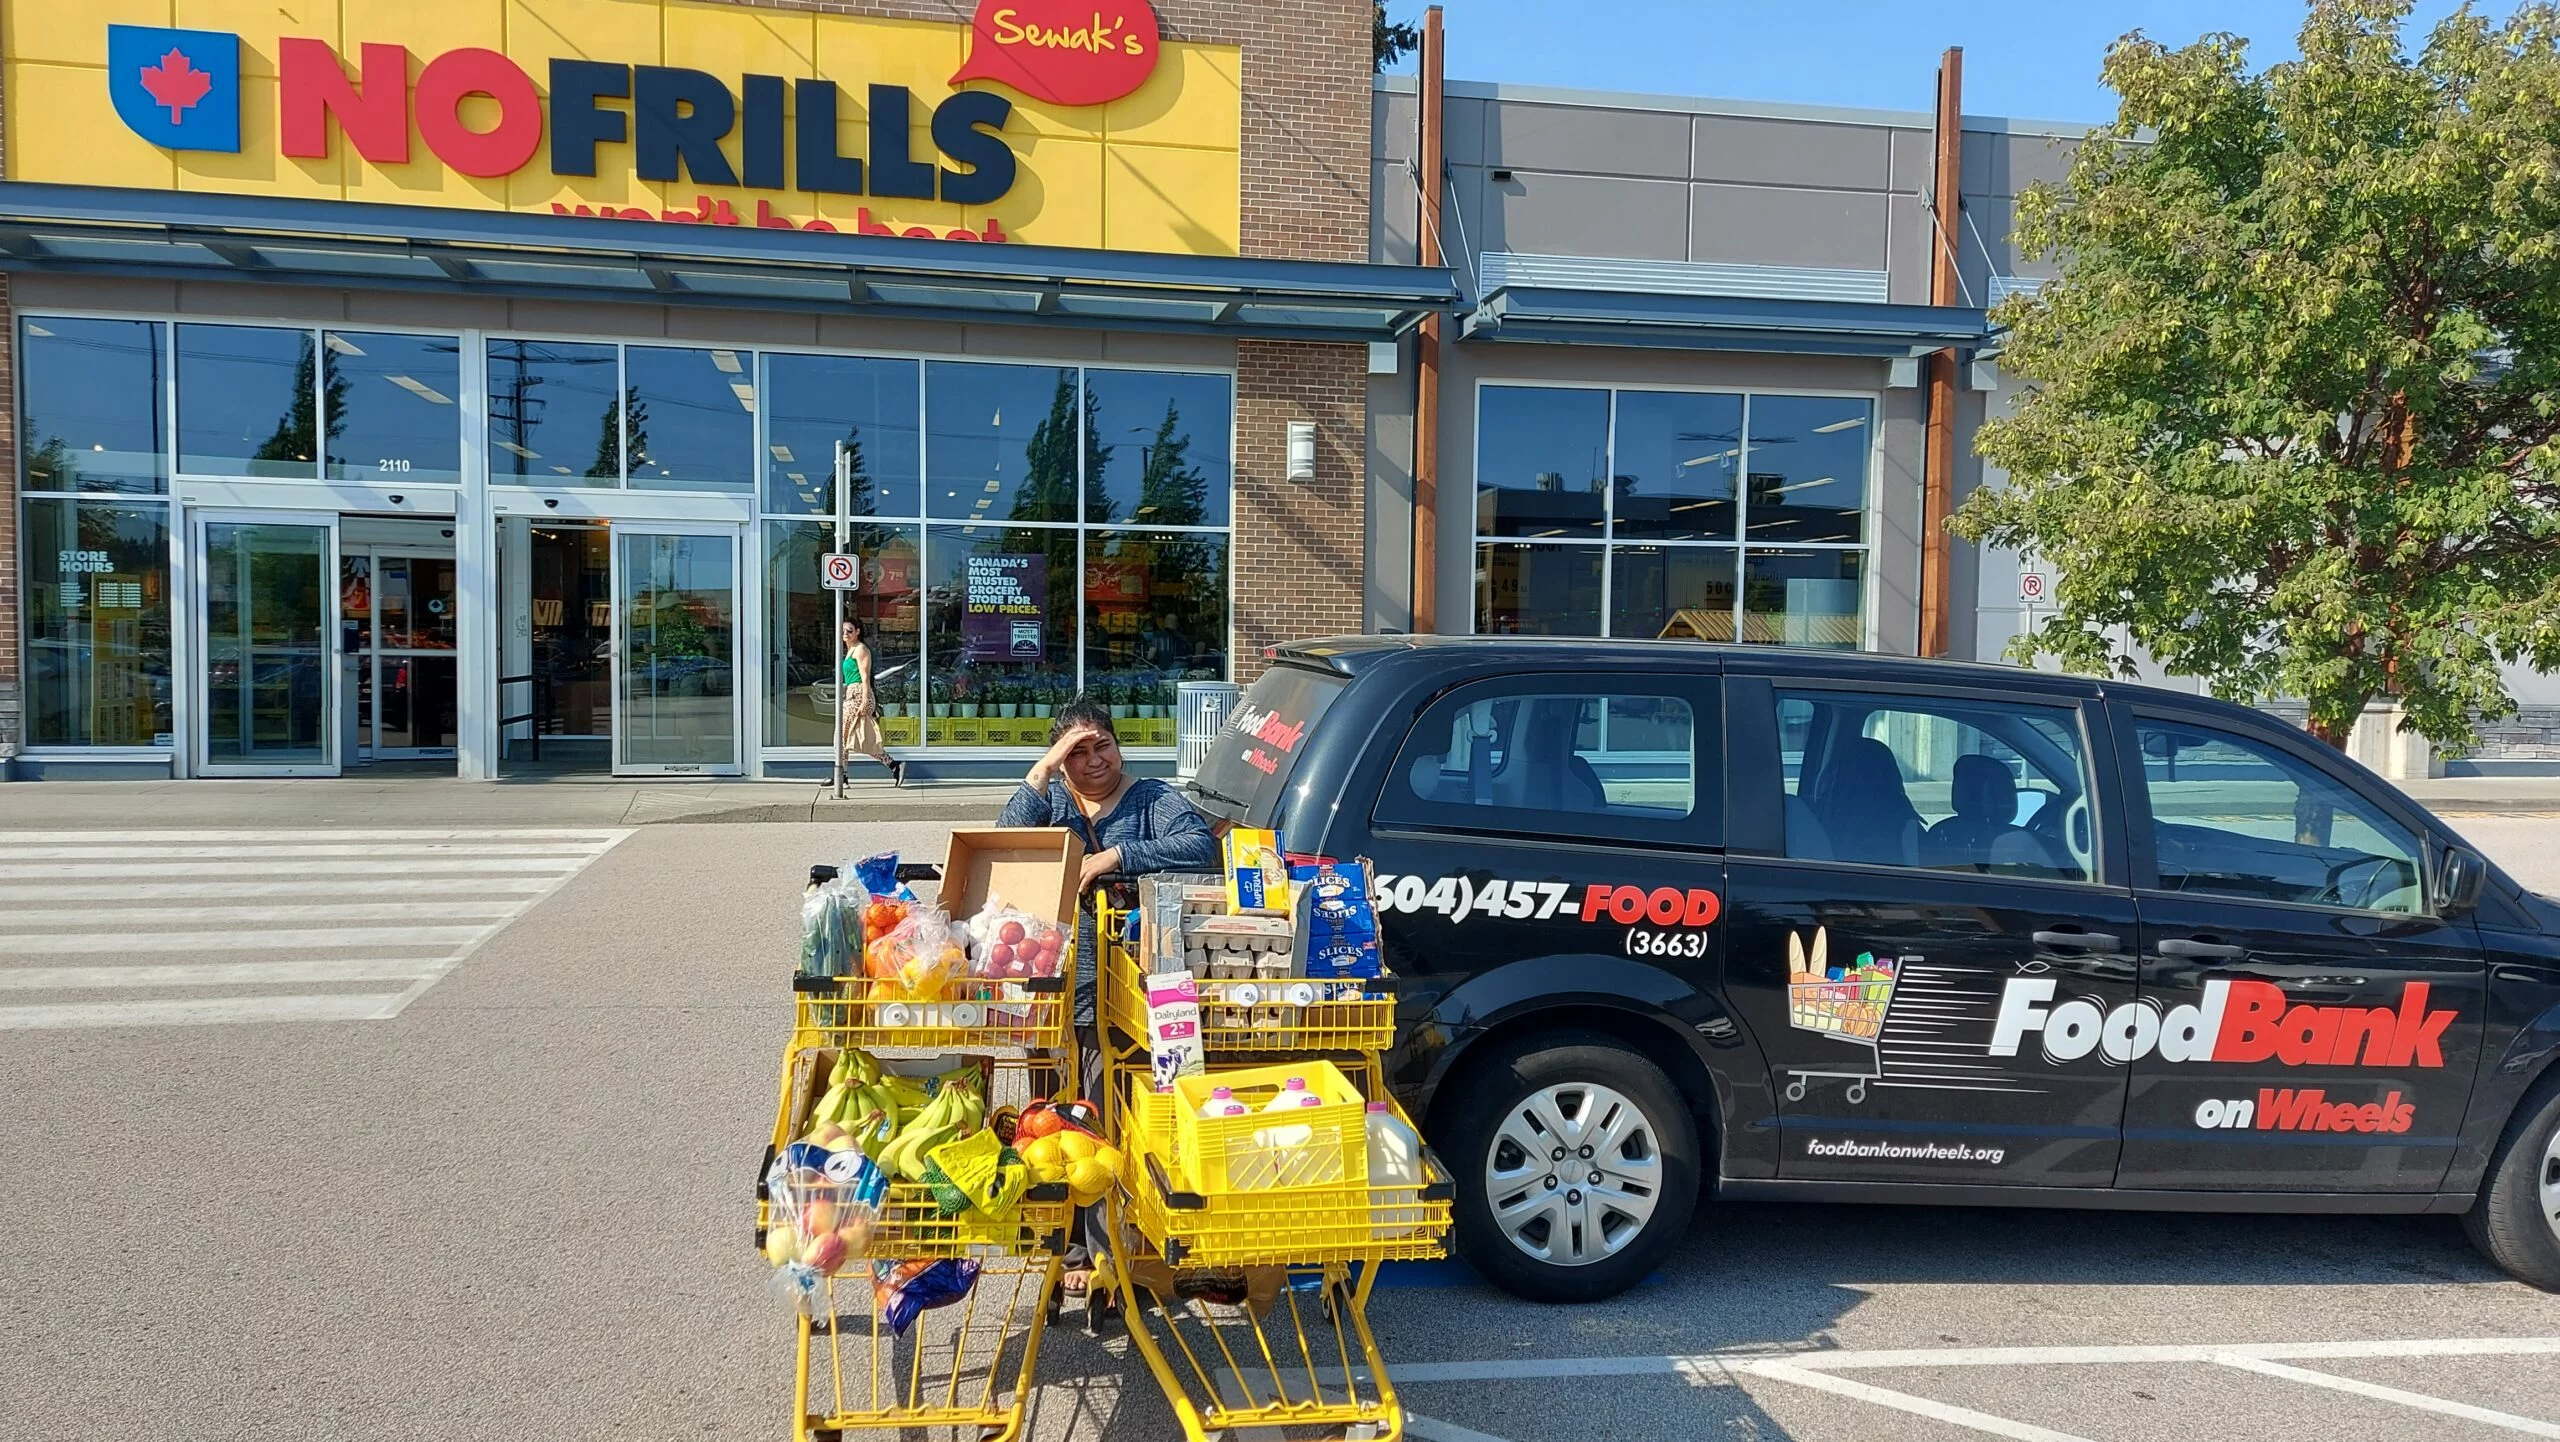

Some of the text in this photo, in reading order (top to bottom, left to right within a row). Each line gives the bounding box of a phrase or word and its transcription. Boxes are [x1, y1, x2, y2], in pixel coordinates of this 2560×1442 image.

[993, 9, 1144, 55] Sewak's
[379, 459, 410, 472] 2110
[59, 550, 108, 562] STORE
[59, 561, 115, 573] HOURS
[968, 557, 1028, 568] CANADA'S
[968, 567, 1002, 576] MOST
[968, 576, 1018, 586] TRUSTED
[968, 585, 1023, 595] GROCERY
[968, 595, 1031, 605] STORE FOR
[968, 604, 995, 613] LOW
[1252, 868, 1264, 907] IMPERIAL
[1313, 904, 1357, 920] SLICES
[1626, 927, 1708, 959] (3663)
[1318, 945, 1364, 960] SLICES
[1154, 1006, 1197, 1020] Dairyland
[1807, 1138, 2005, 1165] foodbankonwheels.org
